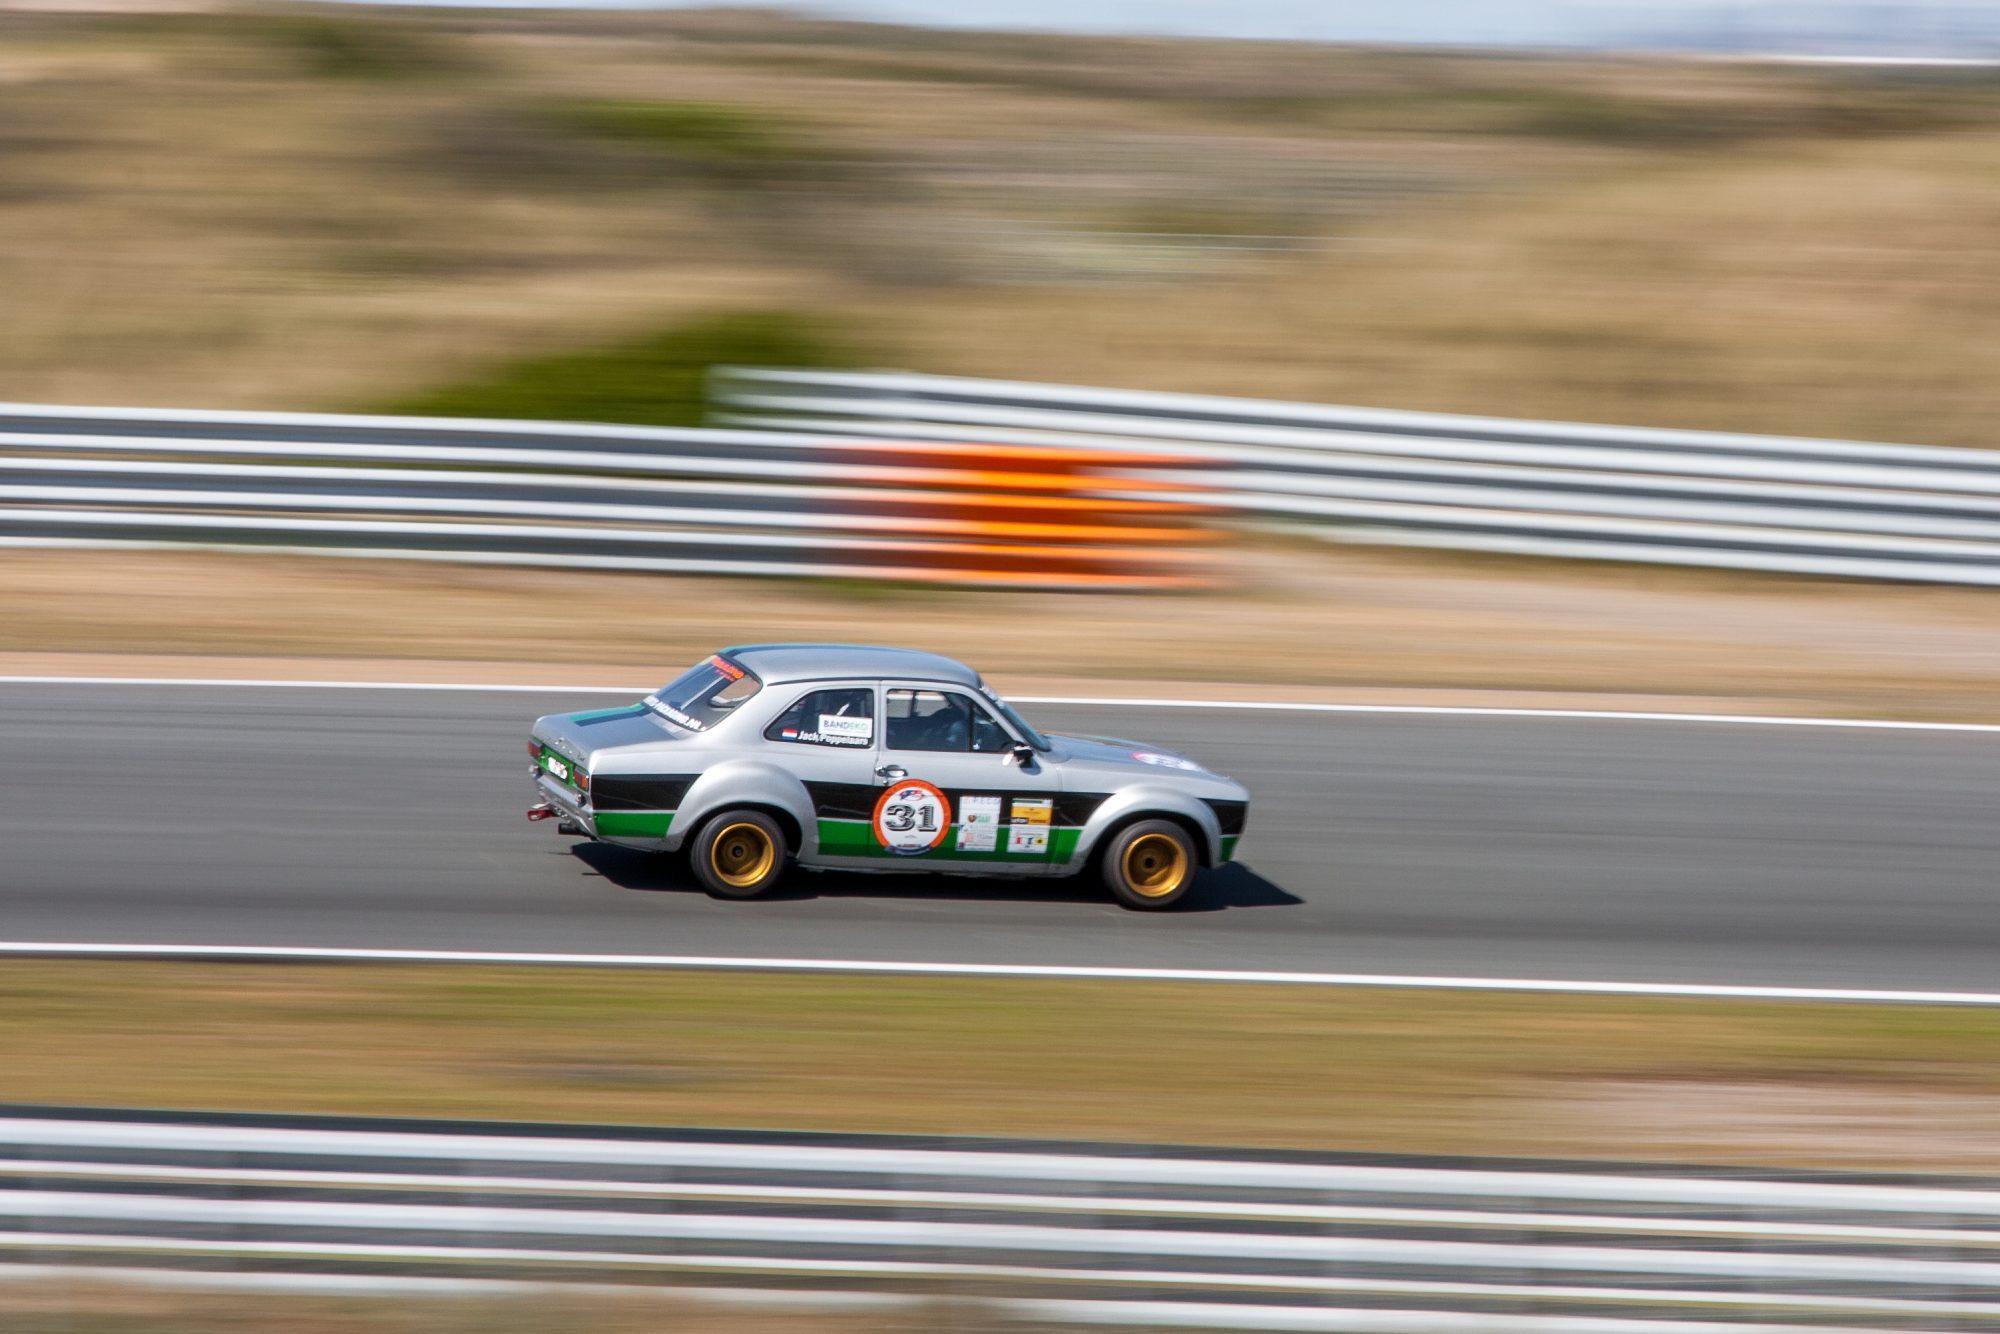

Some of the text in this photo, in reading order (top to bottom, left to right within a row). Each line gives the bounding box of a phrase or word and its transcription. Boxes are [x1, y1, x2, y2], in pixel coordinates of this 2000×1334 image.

[823, 719, 869, 731] BANDEKO
[797, 730, 819, 743] Jack
[885, 803, 938, 832] 31
